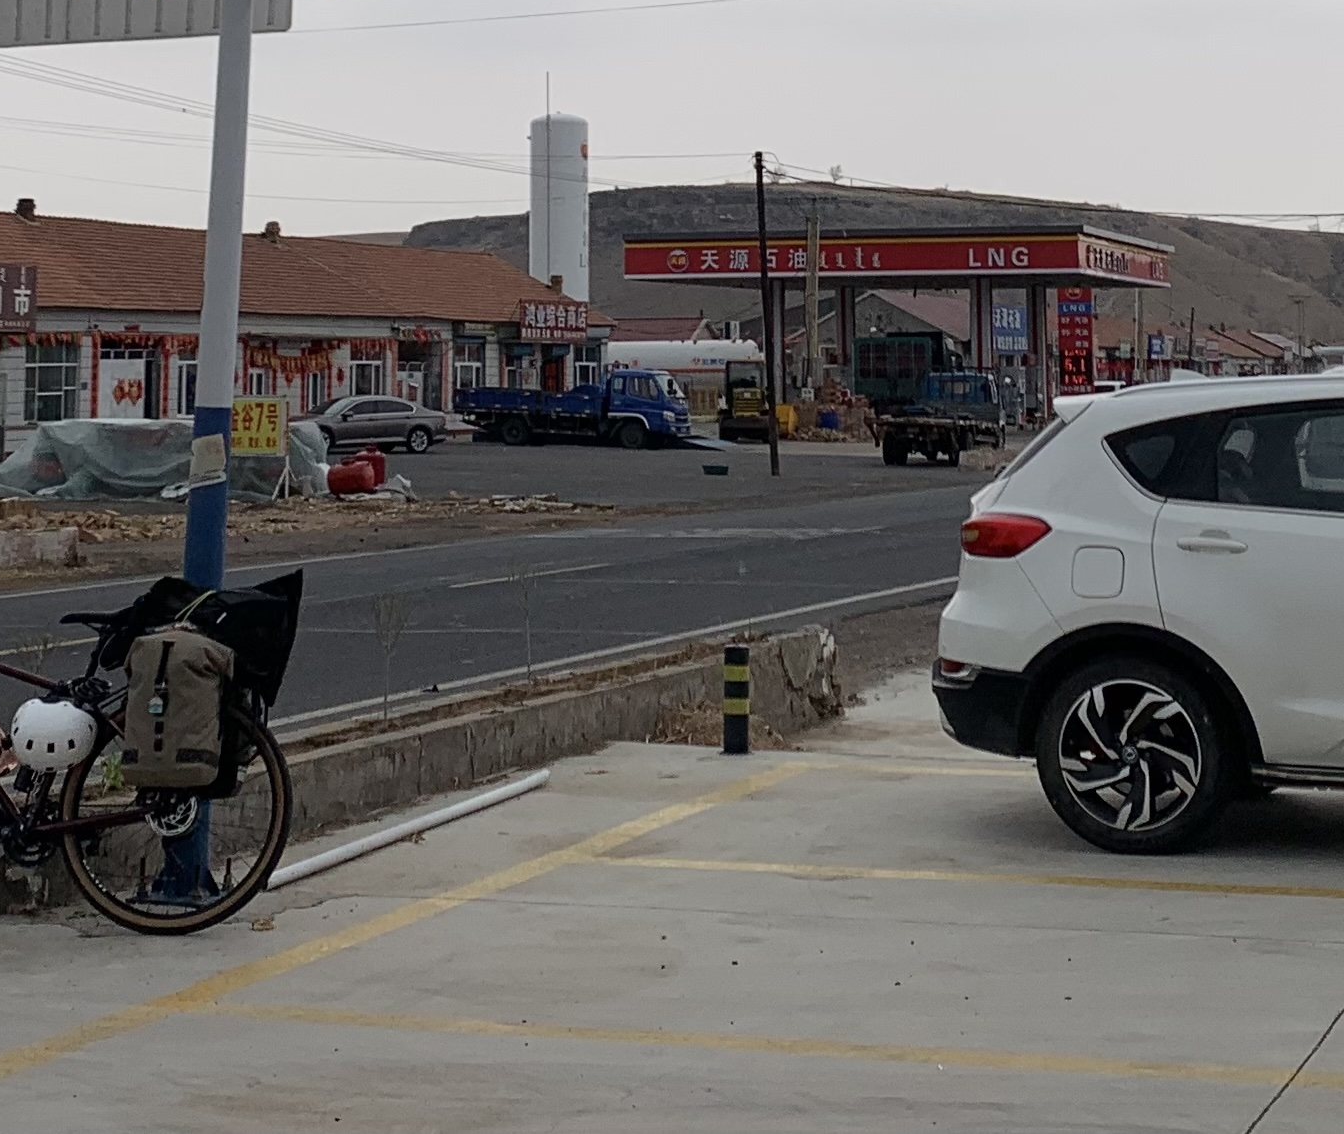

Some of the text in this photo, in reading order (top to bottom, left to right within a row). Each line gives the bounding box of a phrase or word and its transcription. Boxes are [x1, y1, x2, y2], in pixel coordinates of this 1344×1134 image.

[700, 248, 807, 270] 天源石油
[968, 247, 1029, 267] LNG
